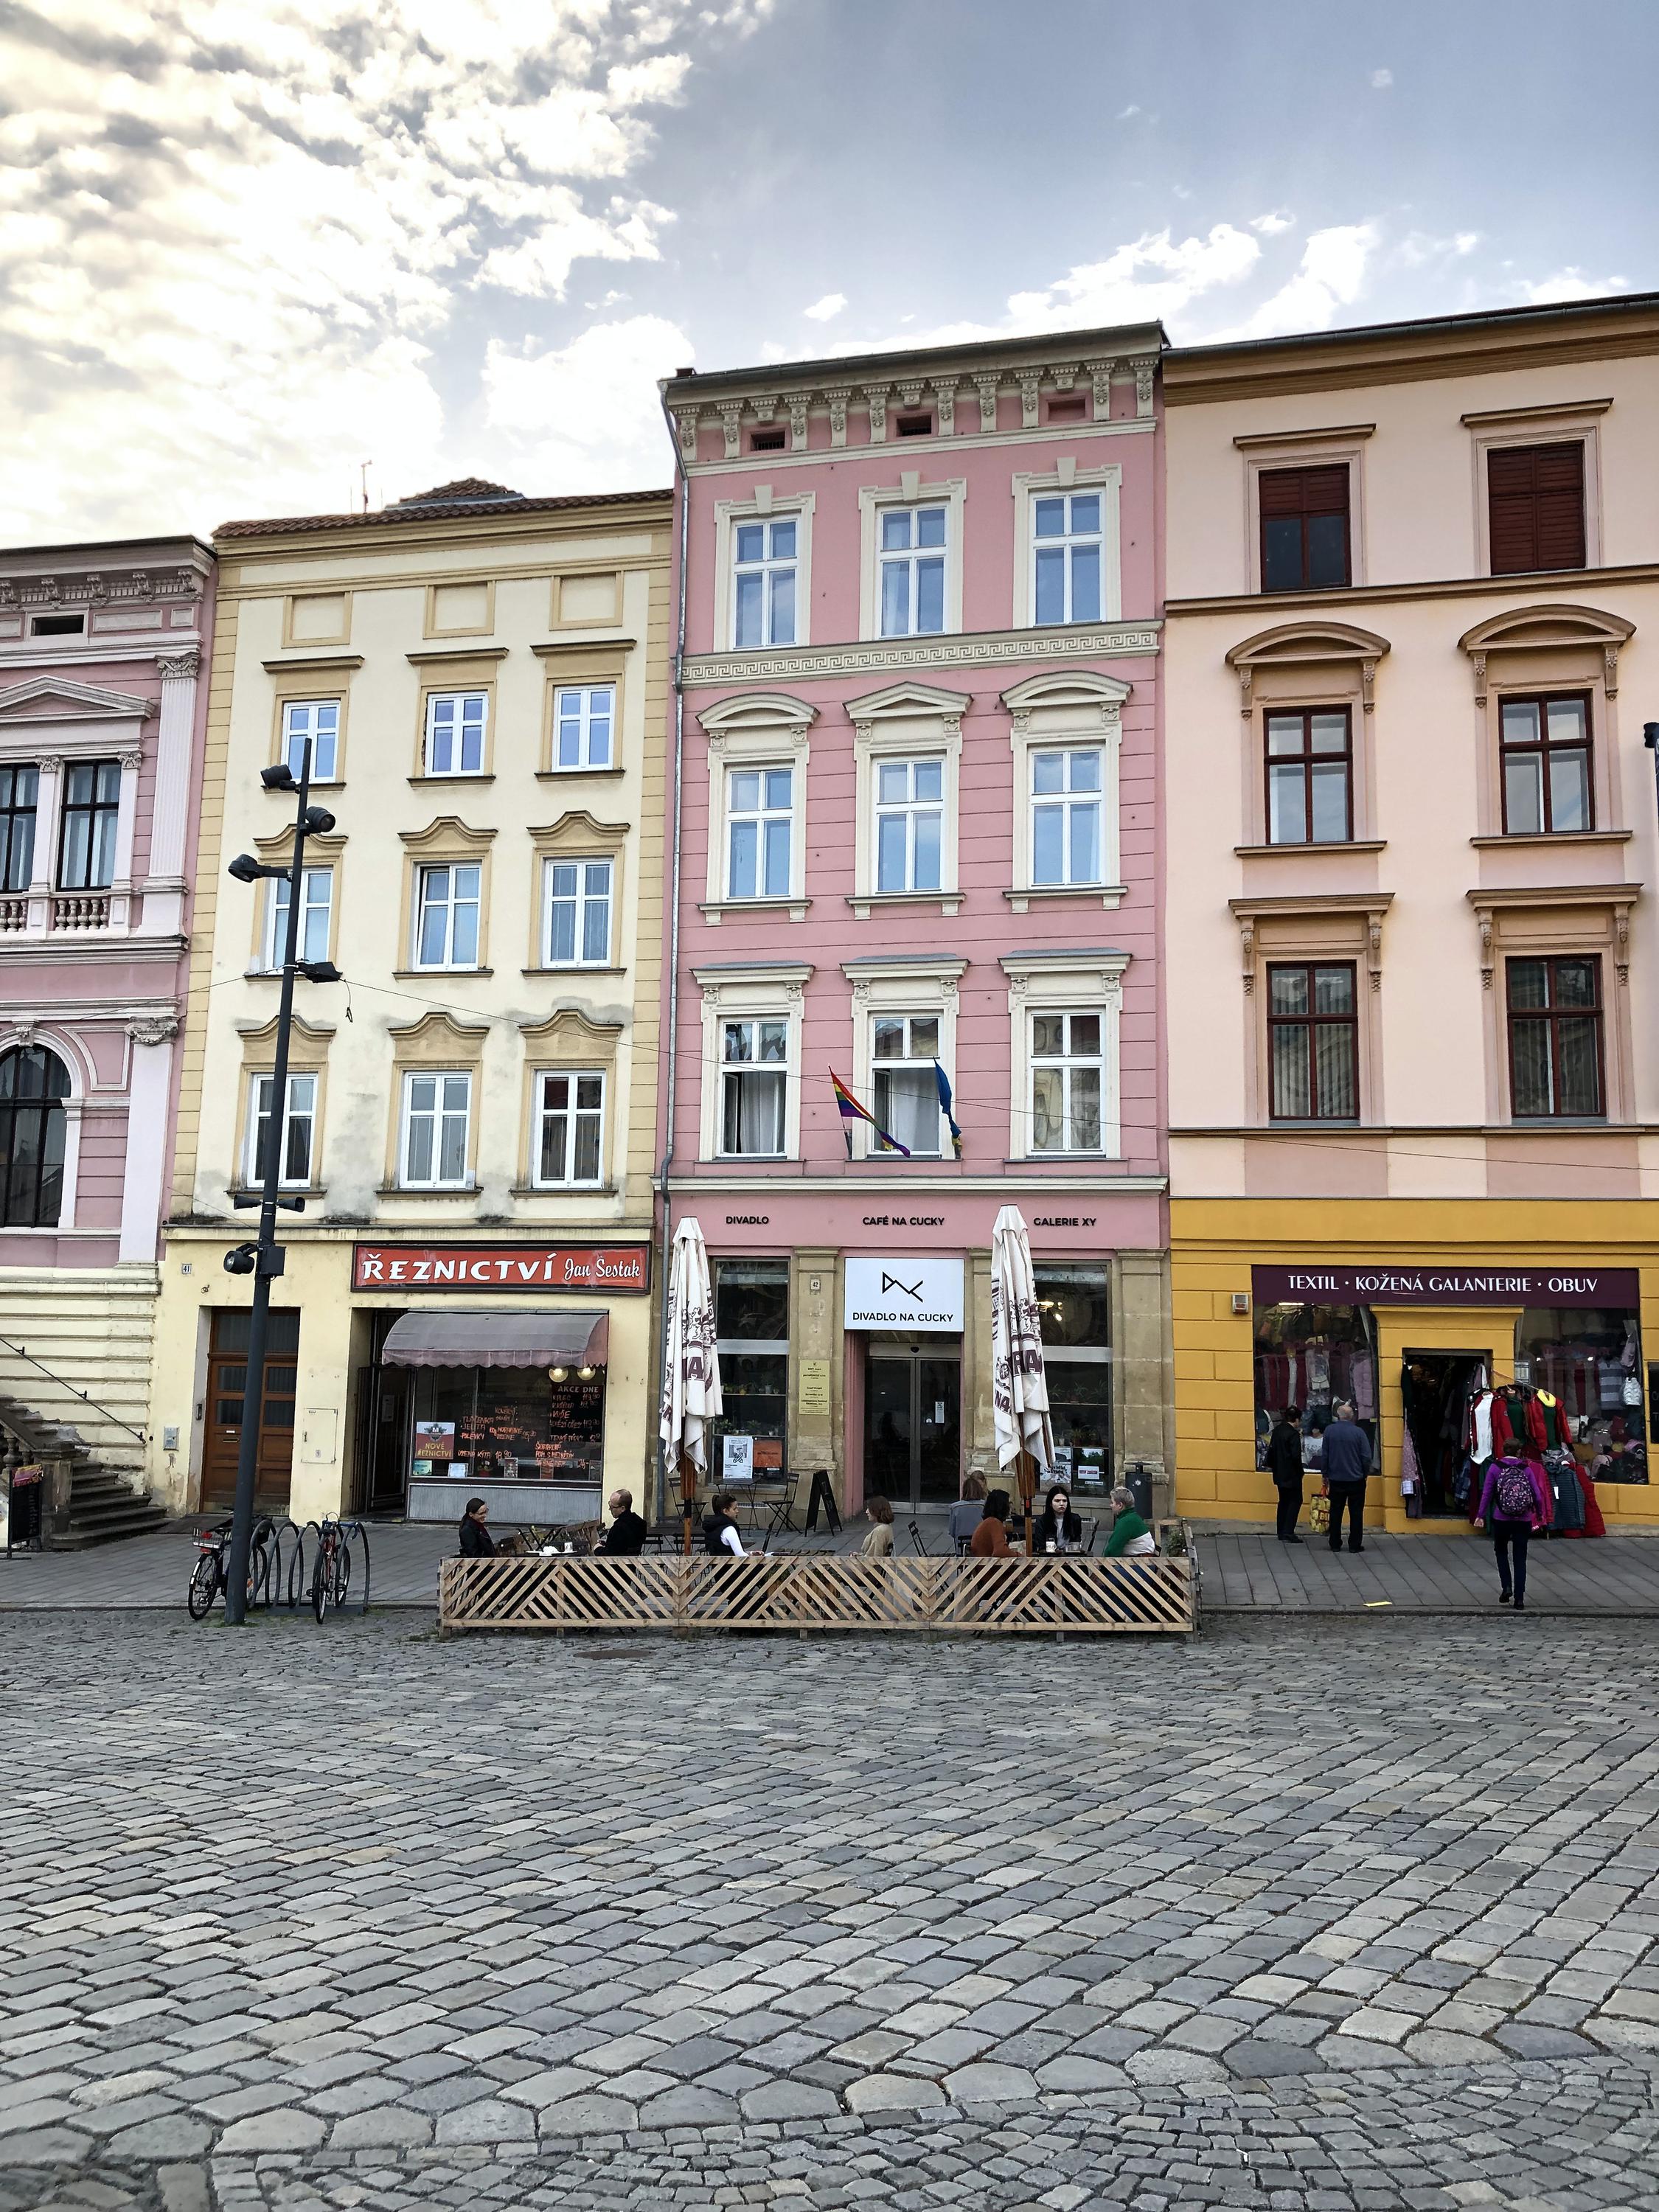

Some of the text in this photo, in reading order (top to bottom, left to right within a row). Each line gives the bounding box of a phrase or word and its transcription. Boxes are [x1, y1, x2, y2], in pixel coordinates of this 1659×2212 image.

[726, 1216, 770, 1225] DIVADLO
[862, 1215, 945, 1226] CAFÉ NA CUCKY
[1033, 1217, 1097, 1226] GALERIE XY
[362, 1253, 641, 1281] ŘEZNICTVÍ Jan Šesták
[1287, 1273, 1598, 1293] TEXTIL KOŽENÁ GALANTERIE OBUV
[852, 1312, 954, 1322] DIVADLO NA CUCKY
[425, 1441, 445, 1450] NOVÉ
[417, 1448, 452, 1458] ŘEZNICTVÍ
